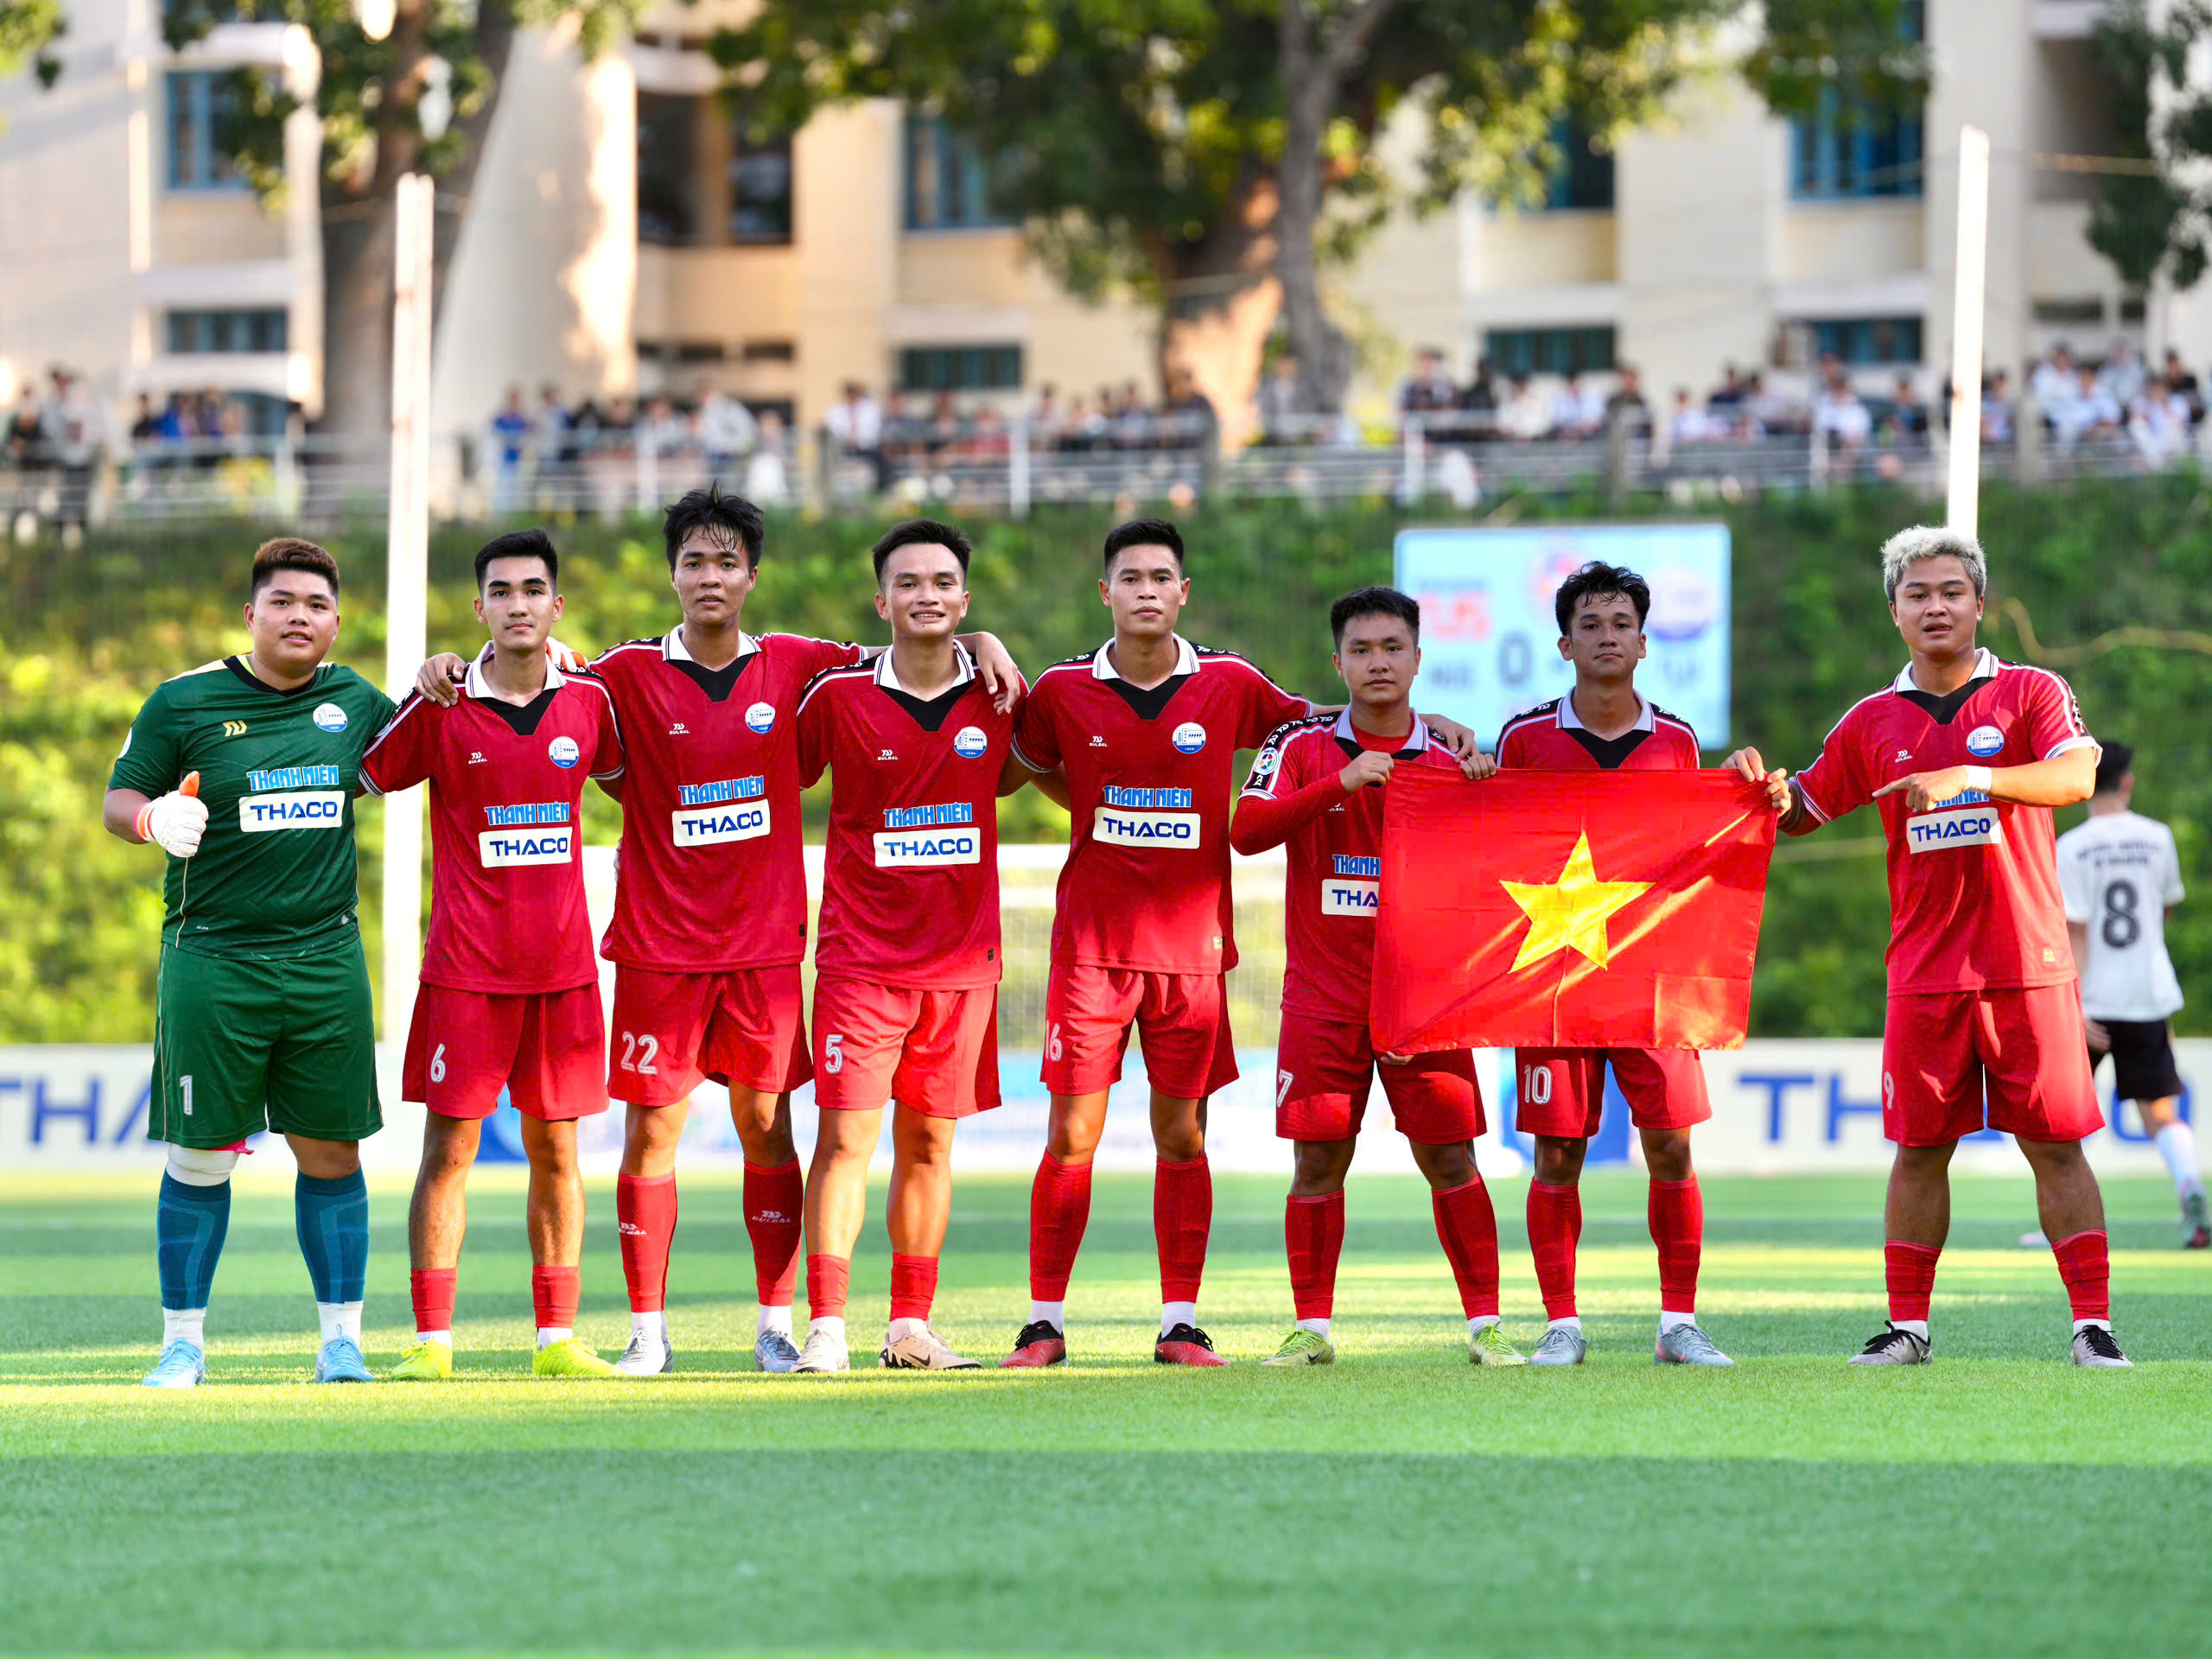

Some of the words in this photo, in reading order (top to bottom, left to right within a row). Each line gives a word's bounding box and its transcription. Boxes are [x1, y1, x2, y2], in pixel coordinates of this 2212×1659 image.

[1499, 632, 1532, 686] 0
[246, 767, 302, 791] THANH
[302, 764, 340, 786] NIÊN
[678, 780, 733, 805] THANH
[733, 775, 765, 799] NIÊN
[1103, 785, 1154, 808] THANH
[1155, 786, 1192, 808] NIÊN
[250, 801, 338, 821] THACO
[484, 804, 537, 826] THANH
[537, 801, 570, 823] NIÊN
[682, 810, 763, 836] THACO
[884, 805, 936, 828] THANH
[936, 802, 973, 823] NIÊN
[1103, 817, 1191, 839] THACO
[1911, 817, 1991, 842] THACO
[489, 837, 568, 856] THACO
[884, 838, 973, 856] THACO
[1332, 854, 1381, 877] THANH
[1332, 889, 1378, 907] THA
[2103, 880, 2141, 950] 8
[431, 1043, 446, 1084] 6
[620, 1031, 658, 1075] 22
[825, 1034, 843, 1074] 5
[180, 1075, 193, 1116] 1
[1277, 1068, 1294, 1108] 7
[1523, 1065, 1552, 1104] 10
[1885, 1071, 1894, 1110] 9
